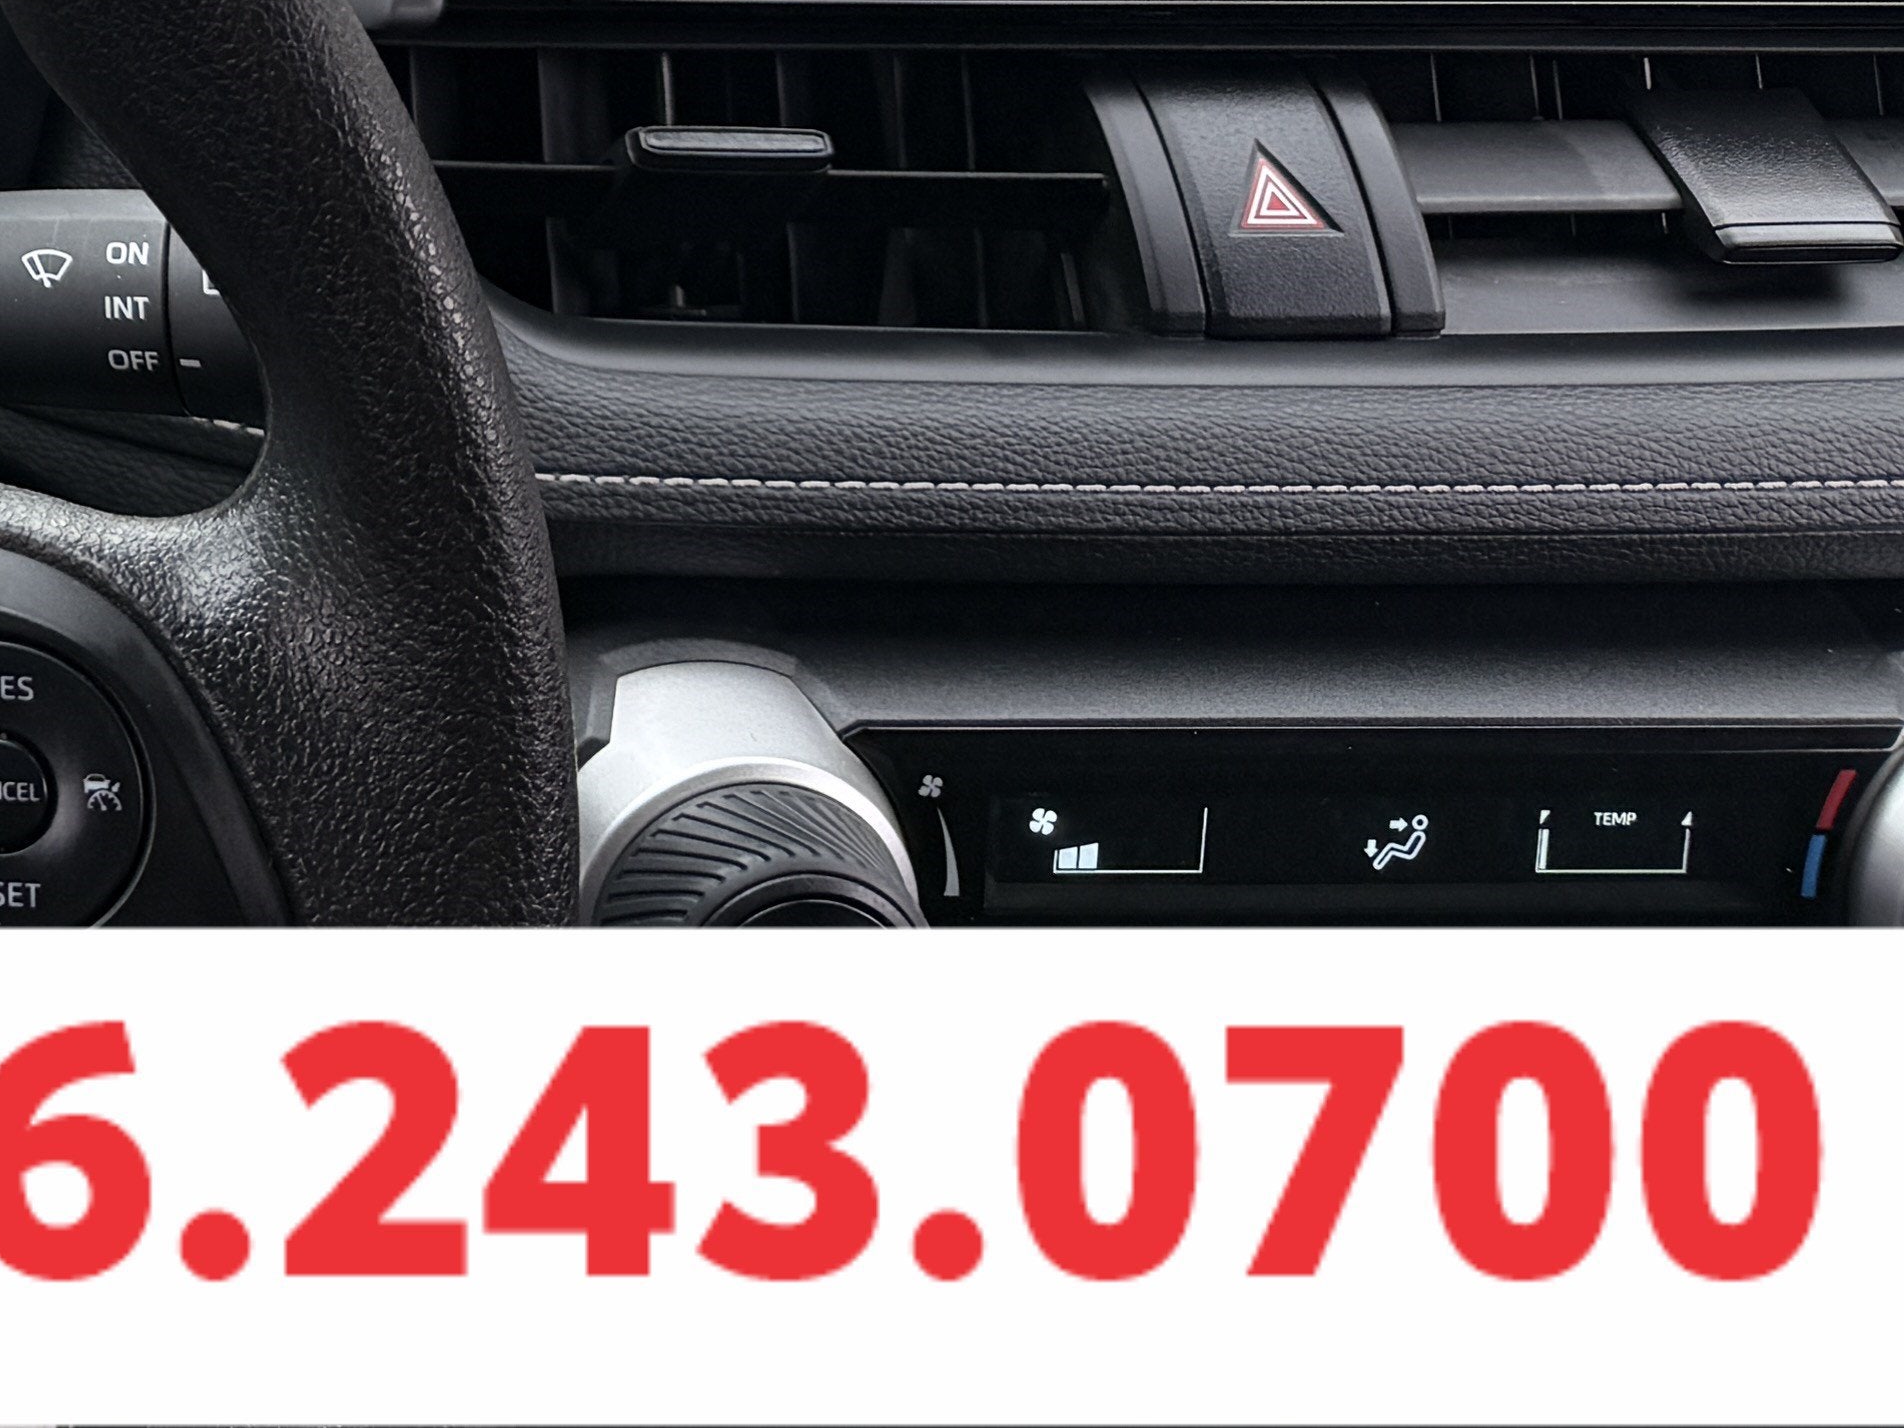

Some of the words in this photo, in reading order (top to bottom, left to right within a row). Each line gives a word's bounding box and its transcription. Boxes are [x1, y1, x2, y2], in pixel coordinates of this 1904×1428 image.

[105, 242, 150, 266] ON
[103, 296, 150, 321] INT
[107, 348, 160, 372] OFF
[1593, 810, 1638, 826] TEMP
